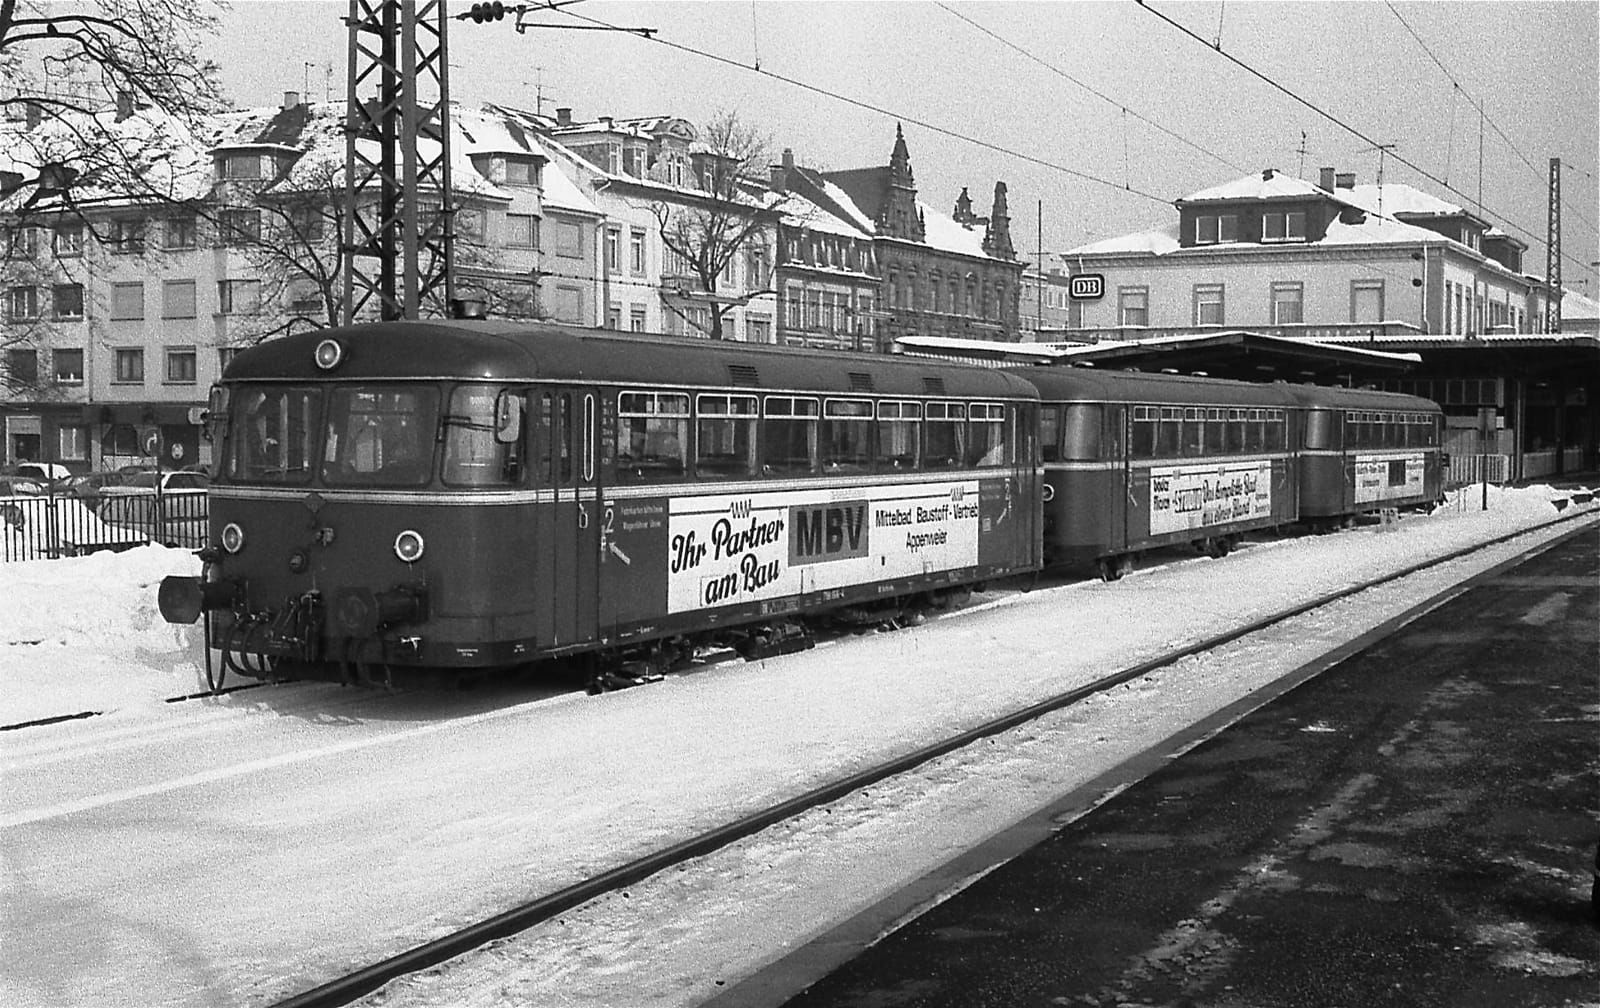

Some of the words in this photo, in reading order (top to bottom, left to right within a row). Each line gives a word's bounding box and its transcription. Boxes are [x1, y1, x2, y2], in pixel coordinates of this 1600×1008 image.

[1076, 281, 1097, 293] DB
[605, 508, 614, 533] 2
[796, 505, 865, 557] MBV
[671, 530, 707, 574] Ihr
[711, 508, 784, 560] Partner
[906, 528, 948, 554] Appenweier
[705, 572, 738, 605] am
[740, 543, 780, 593] Bau
